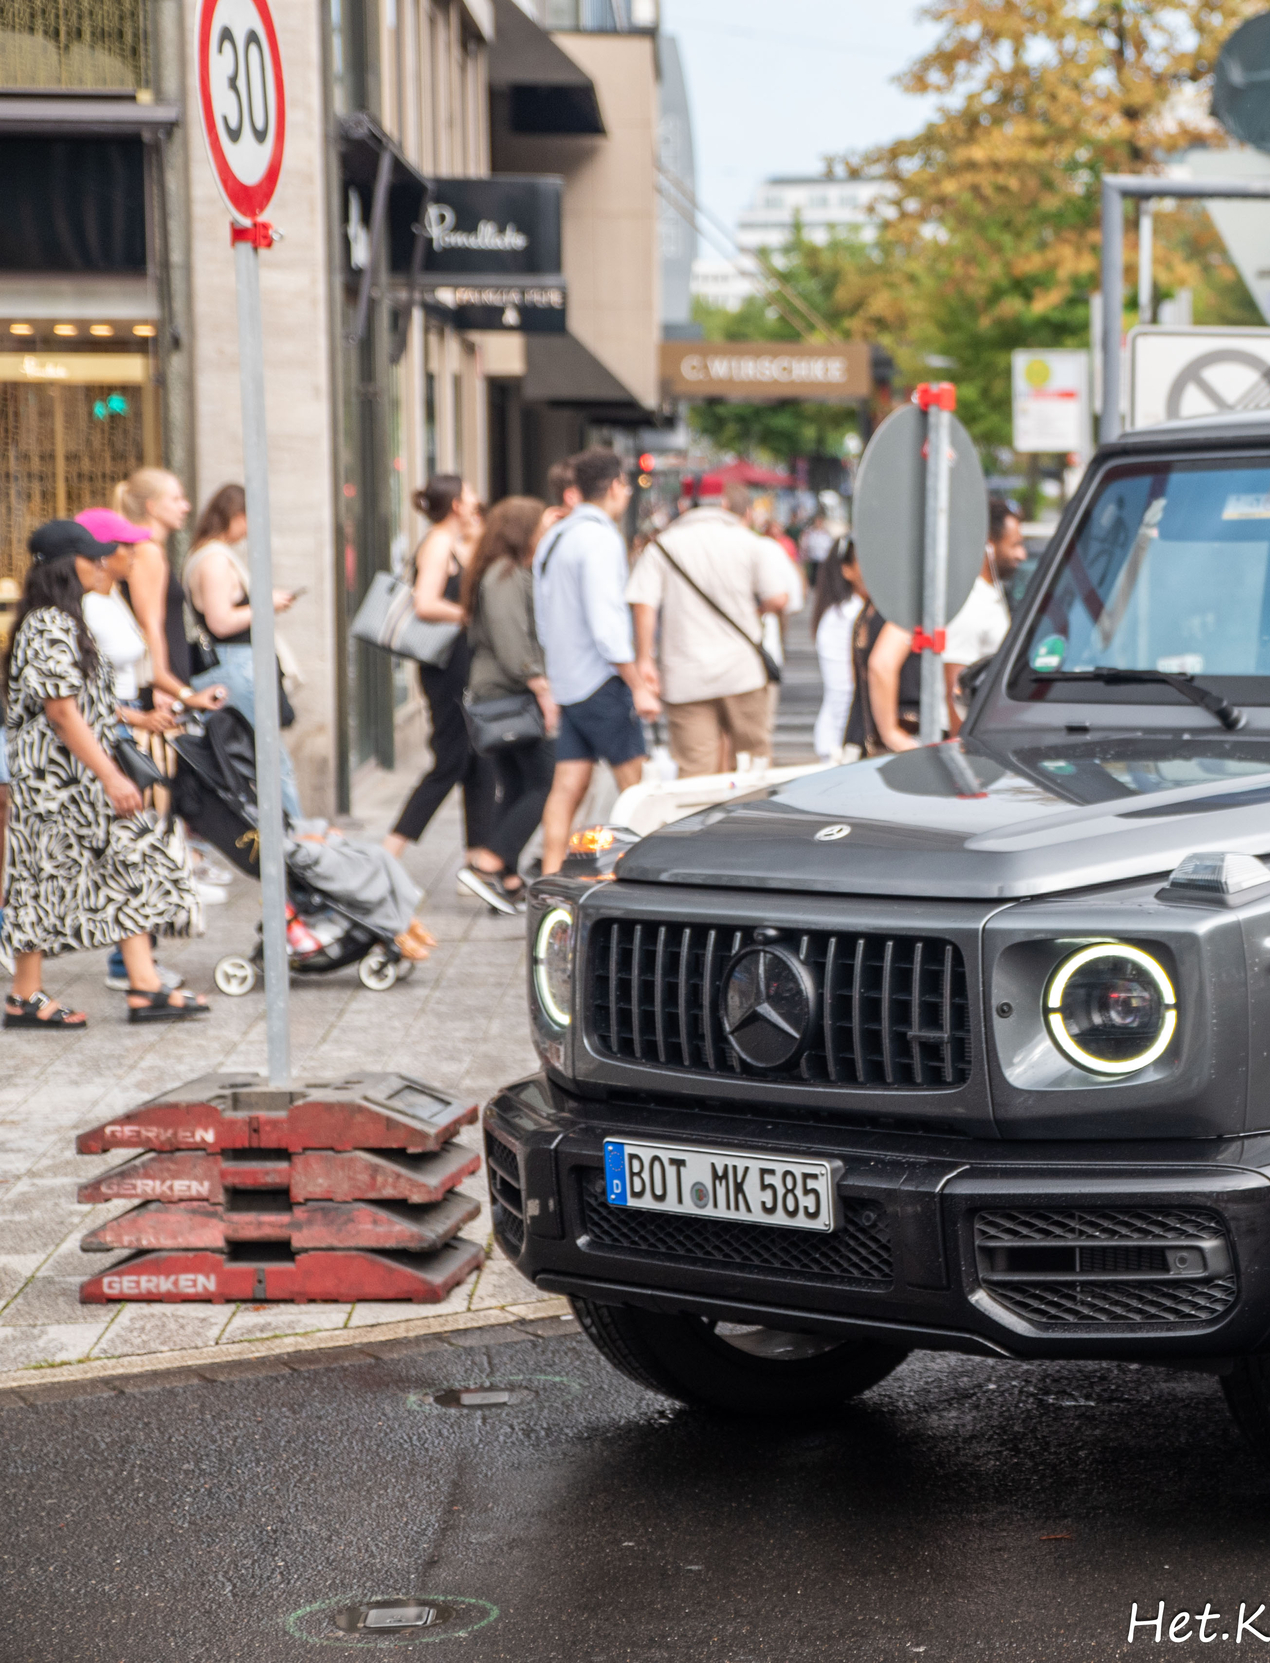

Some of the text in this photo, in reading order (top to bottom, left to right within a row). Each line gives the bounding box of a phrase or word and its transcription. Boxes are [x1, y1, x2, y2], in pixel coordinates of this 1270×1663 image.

[217, 25, 269, 144] 30
[104, 1124, 215, 1144] GERKEN
[100, 1178, 211, 1197] GERKEN
[613, 1179, 622, 1193] D
[627, 1152, 822, 1221] BOT MK 585
[102, 1273, 217, 1295] GERKEN
